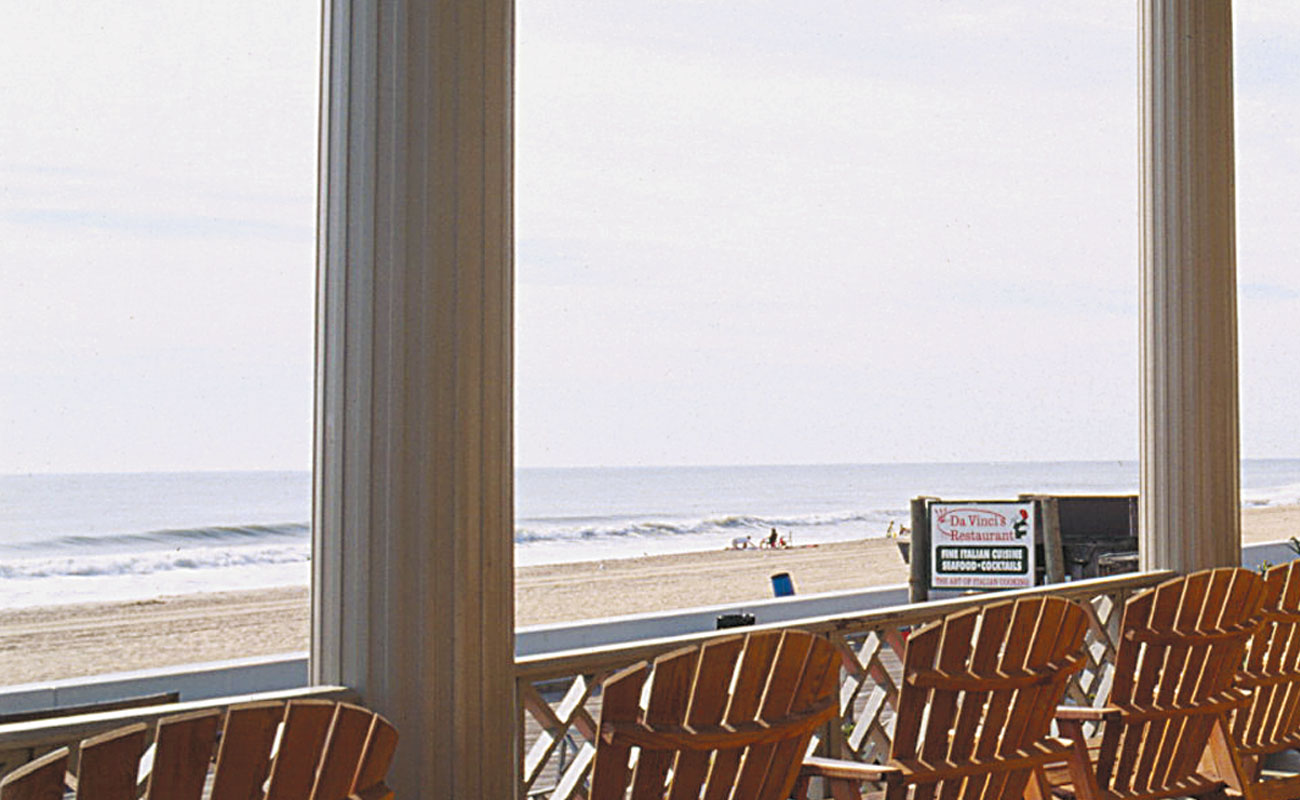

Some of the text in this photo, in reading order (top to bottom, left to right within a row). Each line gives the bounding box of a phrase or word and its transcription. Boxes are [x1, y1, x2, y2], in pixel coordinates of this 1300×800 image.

[950, 514, 1007, 527] Da Vinci's
[950, 530, 1014, 541] Restaurant
[941, 549, 1023, 560] FINE ITALIAN CUISINE
